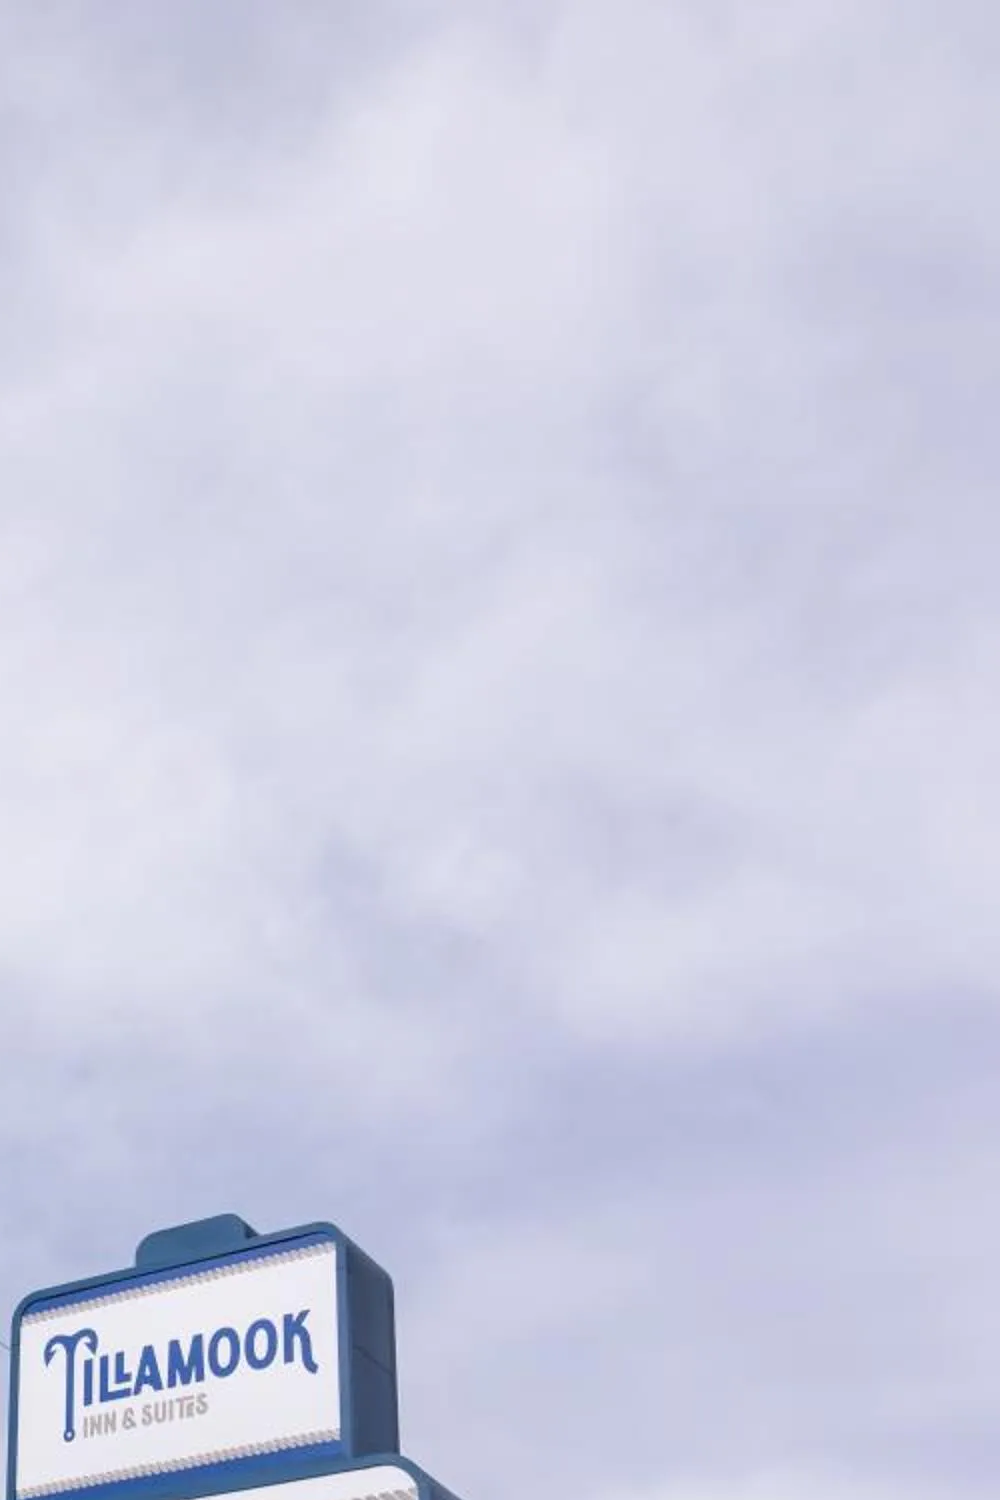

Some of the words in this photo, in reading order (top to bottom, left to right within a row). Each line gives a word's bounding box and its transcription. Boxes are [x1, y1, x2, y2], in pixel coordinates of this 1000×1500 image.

[43, 1308, 318, 1442] TILLAMOOK
[83, 1409, 117, 1438] INN
[122, 1407, 137, 1430] &
[141, 1393, 208, 1426] SUITES
